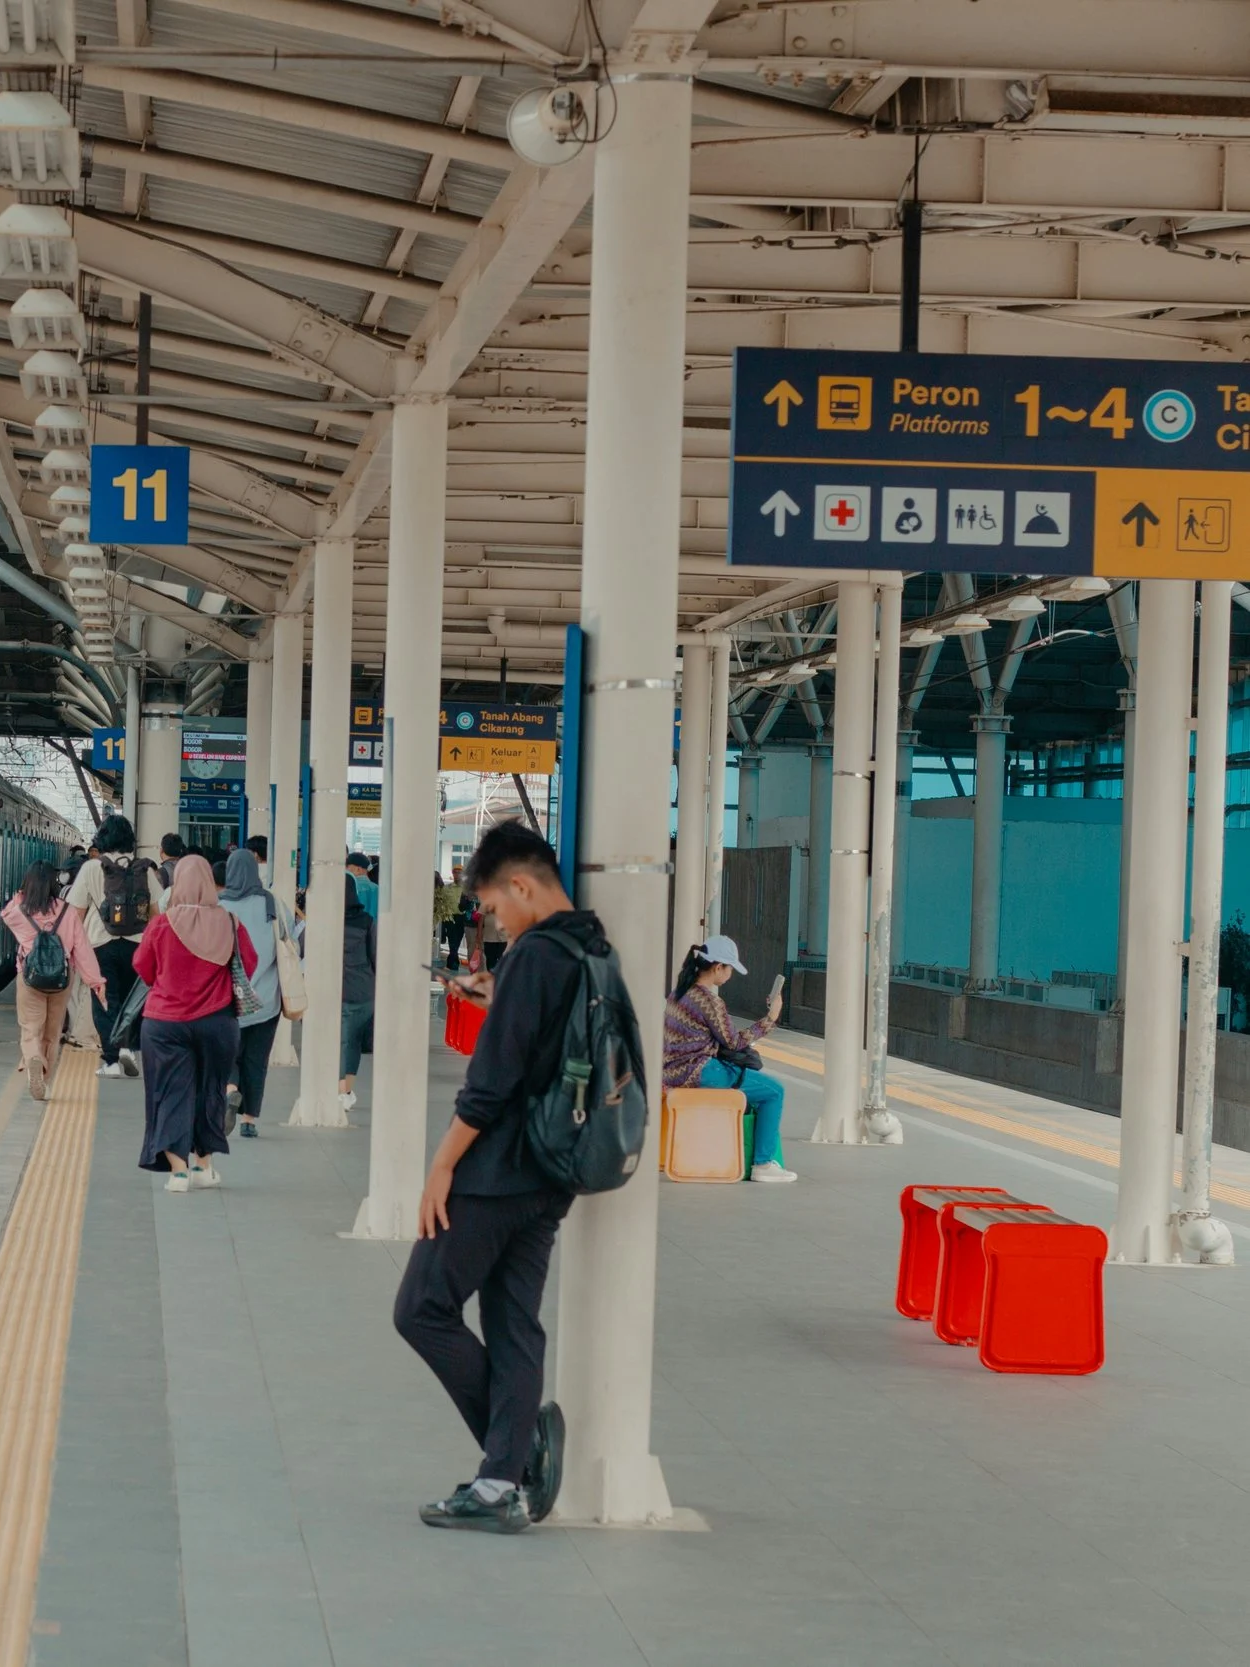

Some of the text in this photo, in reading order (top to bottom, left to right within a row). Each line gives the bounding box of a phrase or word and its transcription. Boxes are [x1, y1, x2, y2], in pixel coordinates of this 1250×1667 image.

[893, 378, 980, 406] Peron
[1014, 384, 1134, 439] 1~4
[889, 412, 990, 436] Platforms
[112, 468, 168, 522] 11
[480, 711, 509, 721] Tanah
[511, 712, 544, 724] Abang
[479, 723, 525, 736] Cikarang
[102, 738, 125, 760] 11
[491, 747, 522, 757] Keluar
